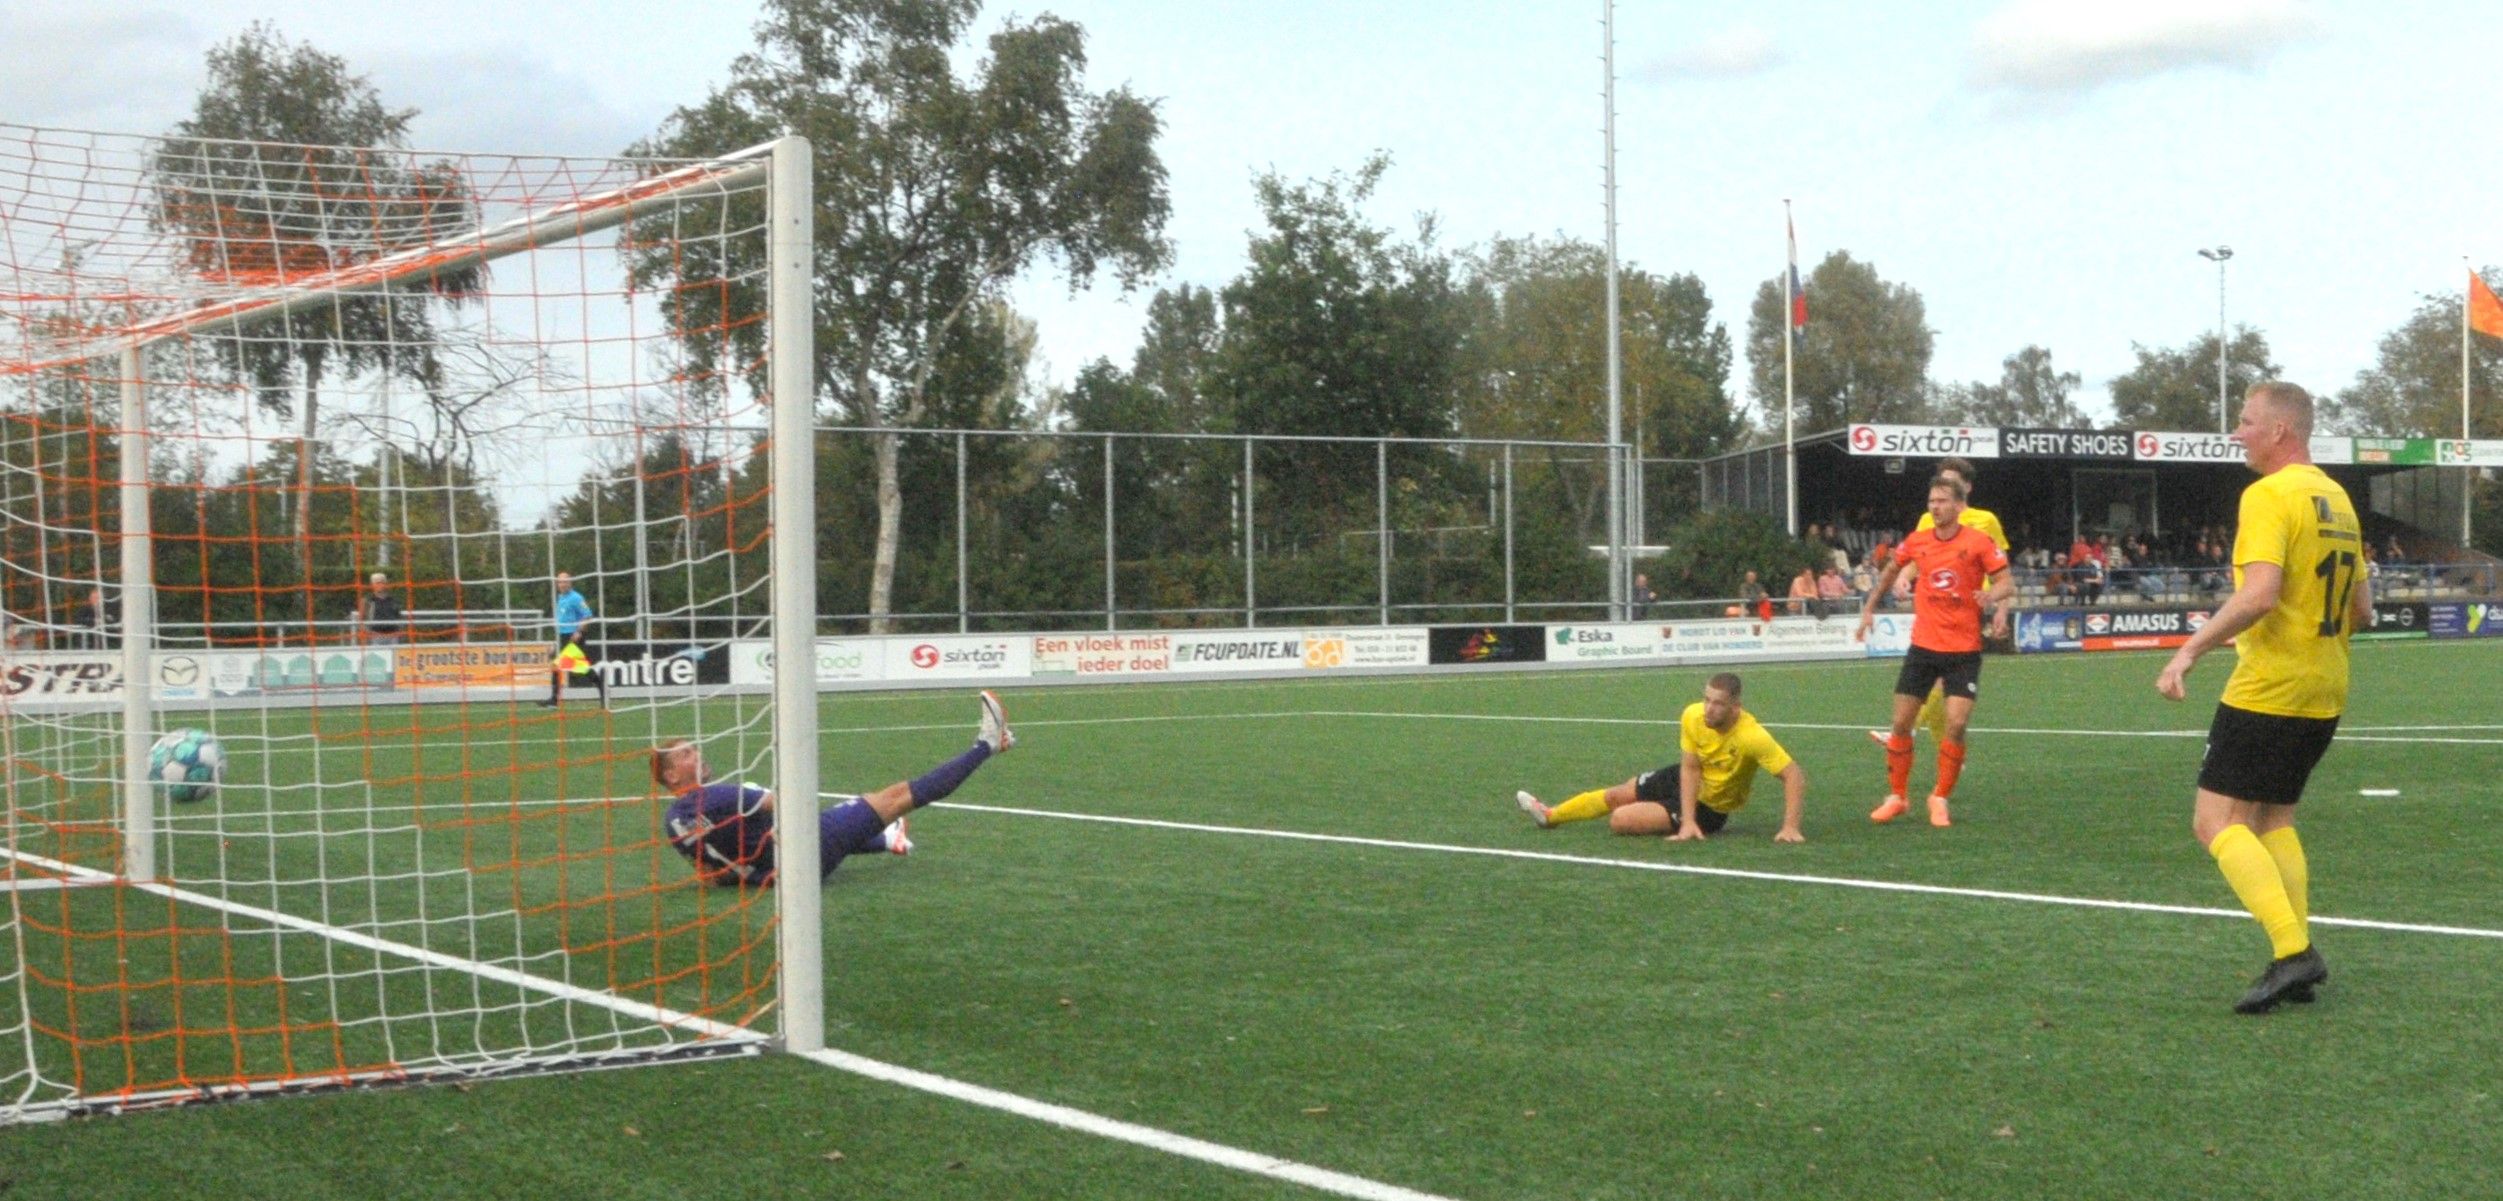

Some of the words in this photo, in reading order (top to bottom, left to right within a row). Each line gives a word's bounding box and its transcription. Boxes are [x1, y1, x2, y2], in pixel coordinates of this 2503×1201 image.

[2006, 432, 2067, 454] SAFETY
[2071, 434, 2128, 456] SHOES
[2315, 549, 2356, 637] 17
[2112, 613, 2180, 632] AMASUS
[1035, 638, 1068, 654] Een
[1074, 635, 1125, 652] vloek
[1129, 634, 1170, 651] mist
[1578, 628, 1613, 643] Eska
[1193, 640, 1300, 662] FCUPDATE.NL
[594, 653, 695, 686] mitre
[1078, 656, 1125, 673] ieder
[1129, 655, 1170, 671] doel
